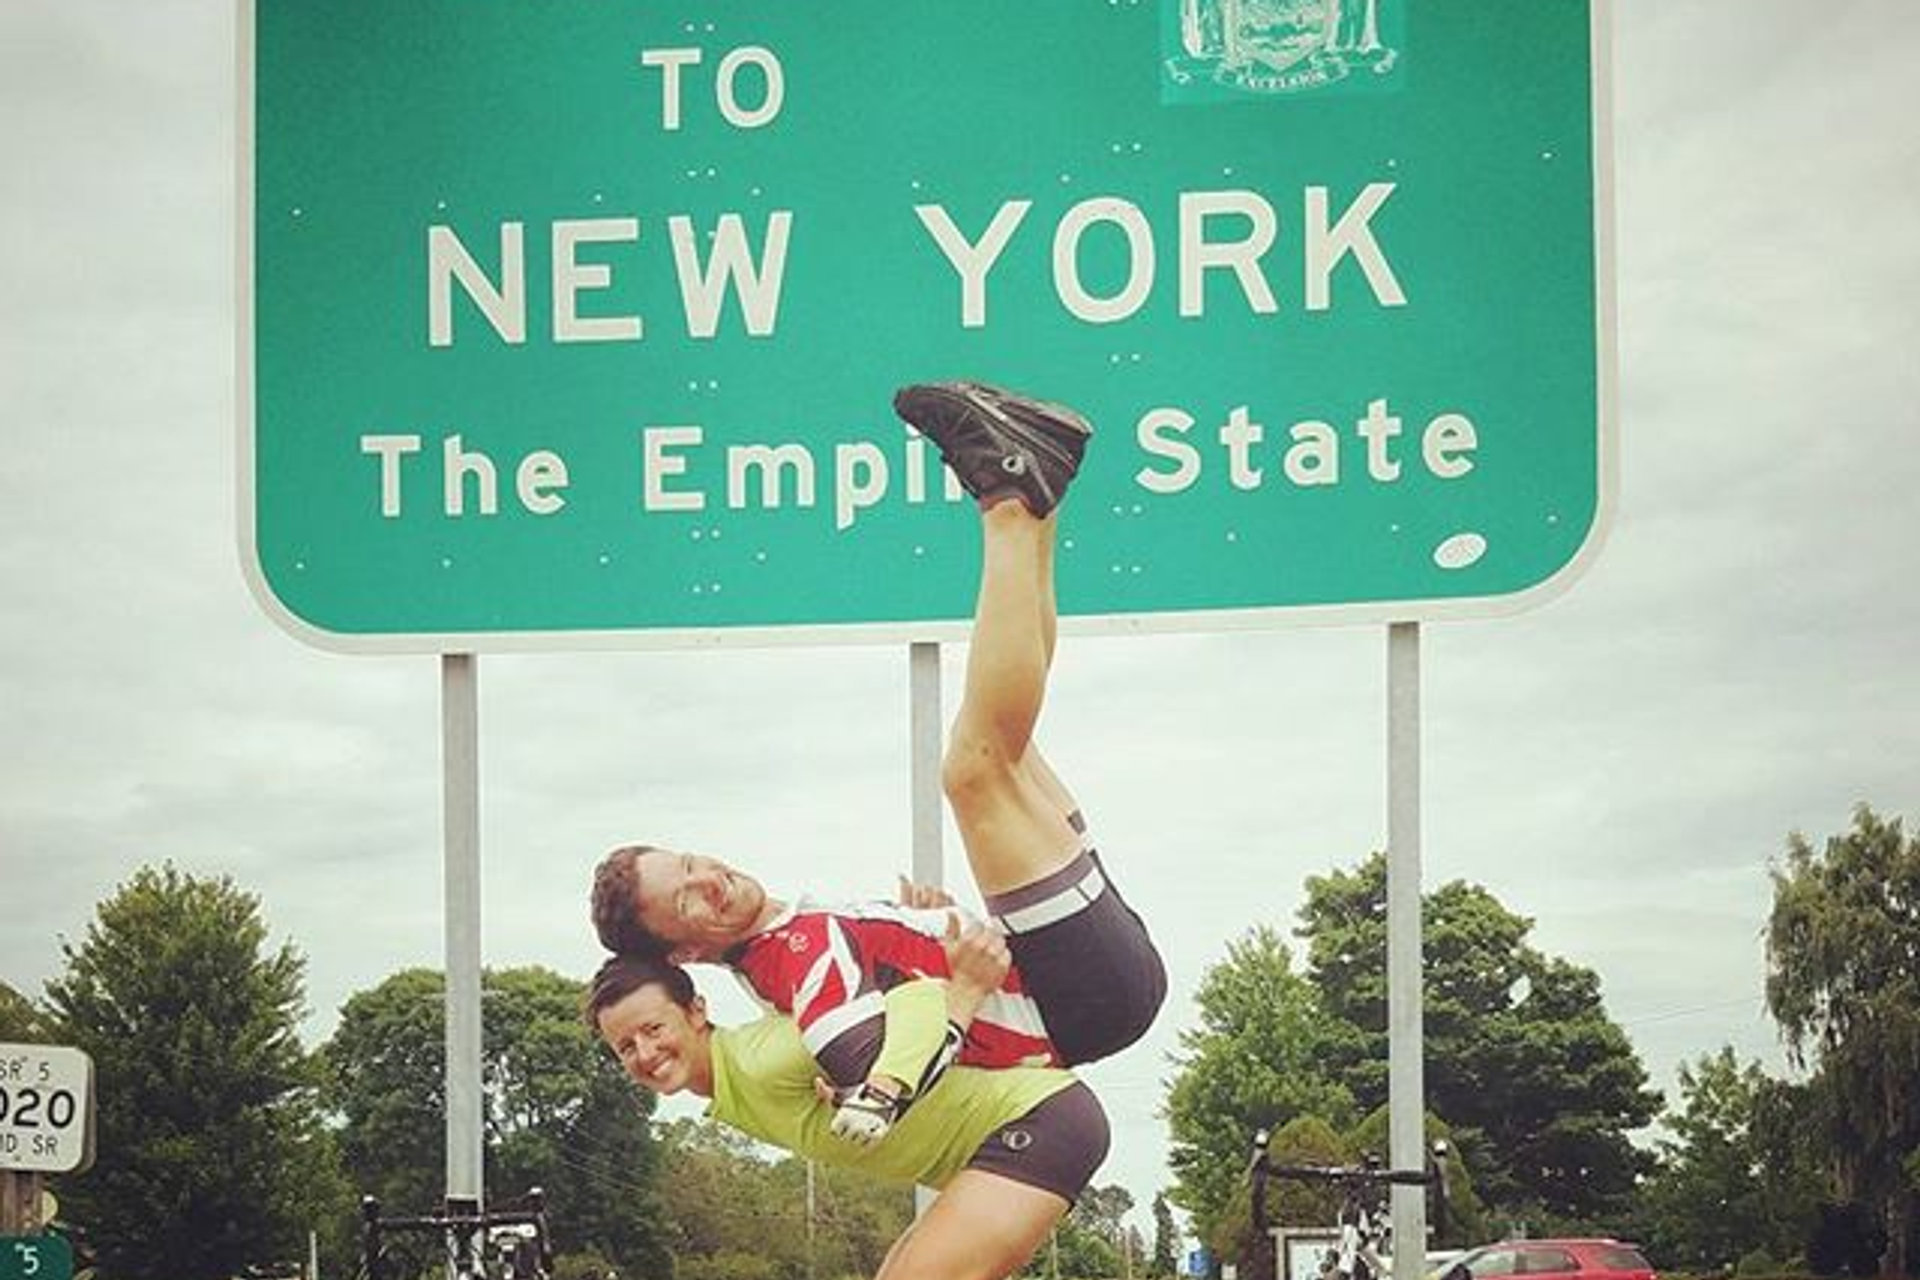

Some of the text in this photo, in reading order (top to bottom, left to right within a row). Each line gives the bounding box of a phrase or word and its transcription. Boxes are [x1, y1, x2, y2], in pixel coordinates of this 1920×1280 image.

[642, 46, 784, 131] TO
[427, 182, 1408, 346] NEW YORK
[360, 434, 571, 517] The
[1136, 397, 1479, 493] State
[39, 1061, 49, 1081] 5
[33, 1133, 58, 1156] SR
[23, 1245, 40, 1274] 5
